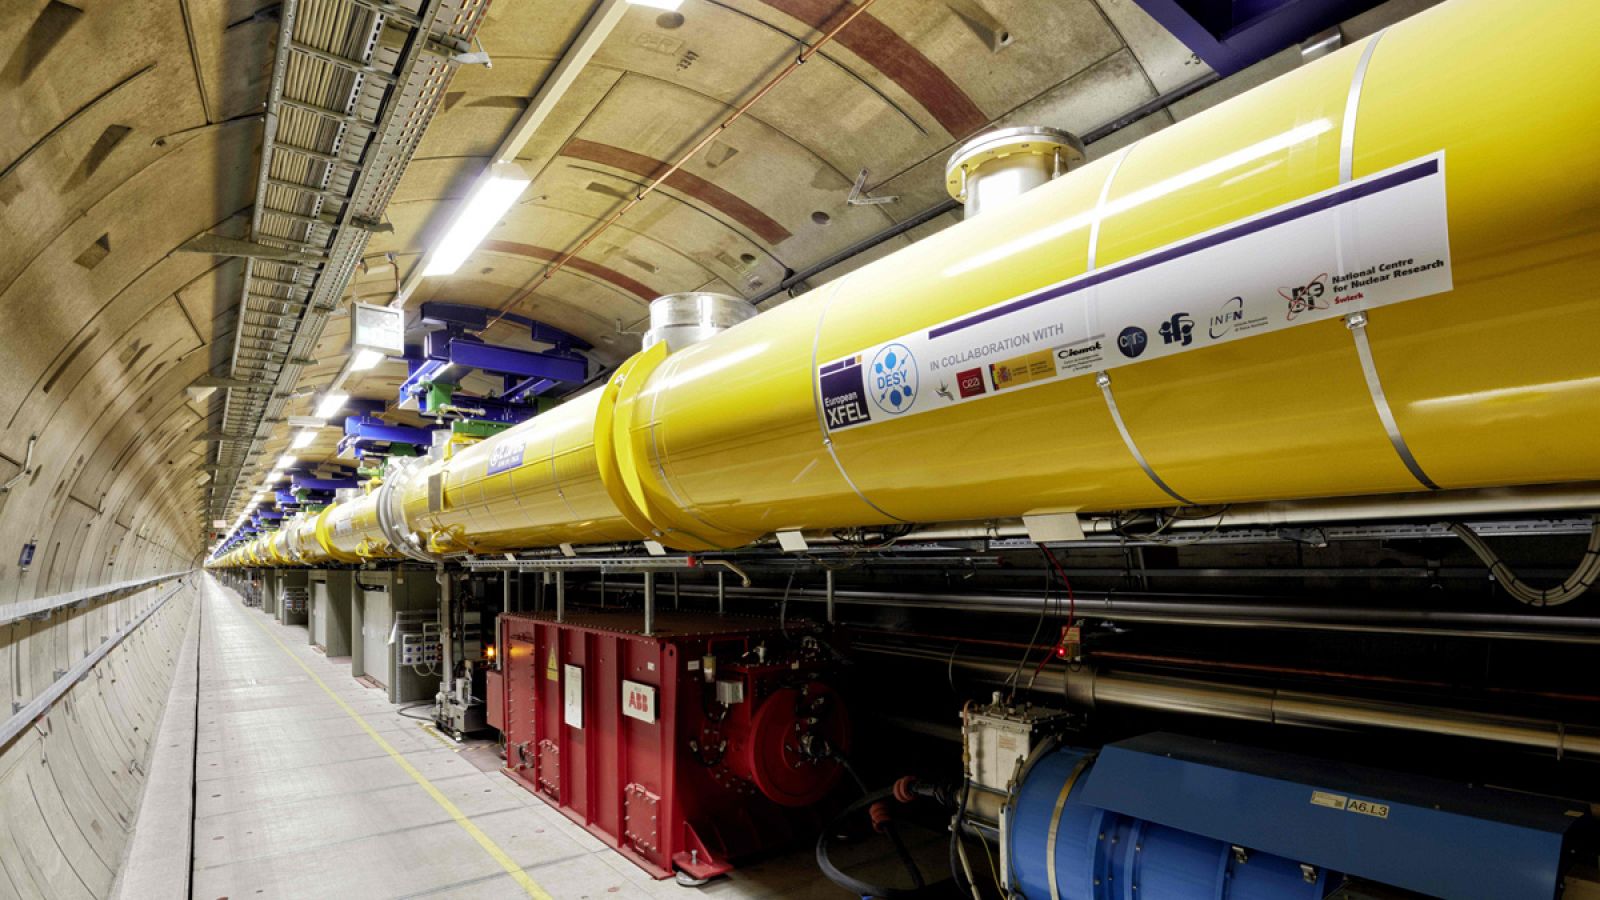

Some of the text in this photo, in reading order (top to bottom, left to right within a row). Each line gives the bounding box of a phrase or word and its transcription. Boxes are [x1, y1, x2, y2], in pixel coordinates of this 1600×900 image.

[1332, 257, 1414, 284] National Centre
[1333, 259, 1444, 293] for Nuclear Research
[1210, 310, 1243, 326] INFN
[930, 323, 1064, 371] IN COLLABORATION WITH
[877, 369, 908, 389] DESY
[825, 391, 858, 407] European
[827, 401, 868, 427] XFEL
[628, 692, 649, 712] ABB
[1348, 800, 1388, 816] A6.L3
